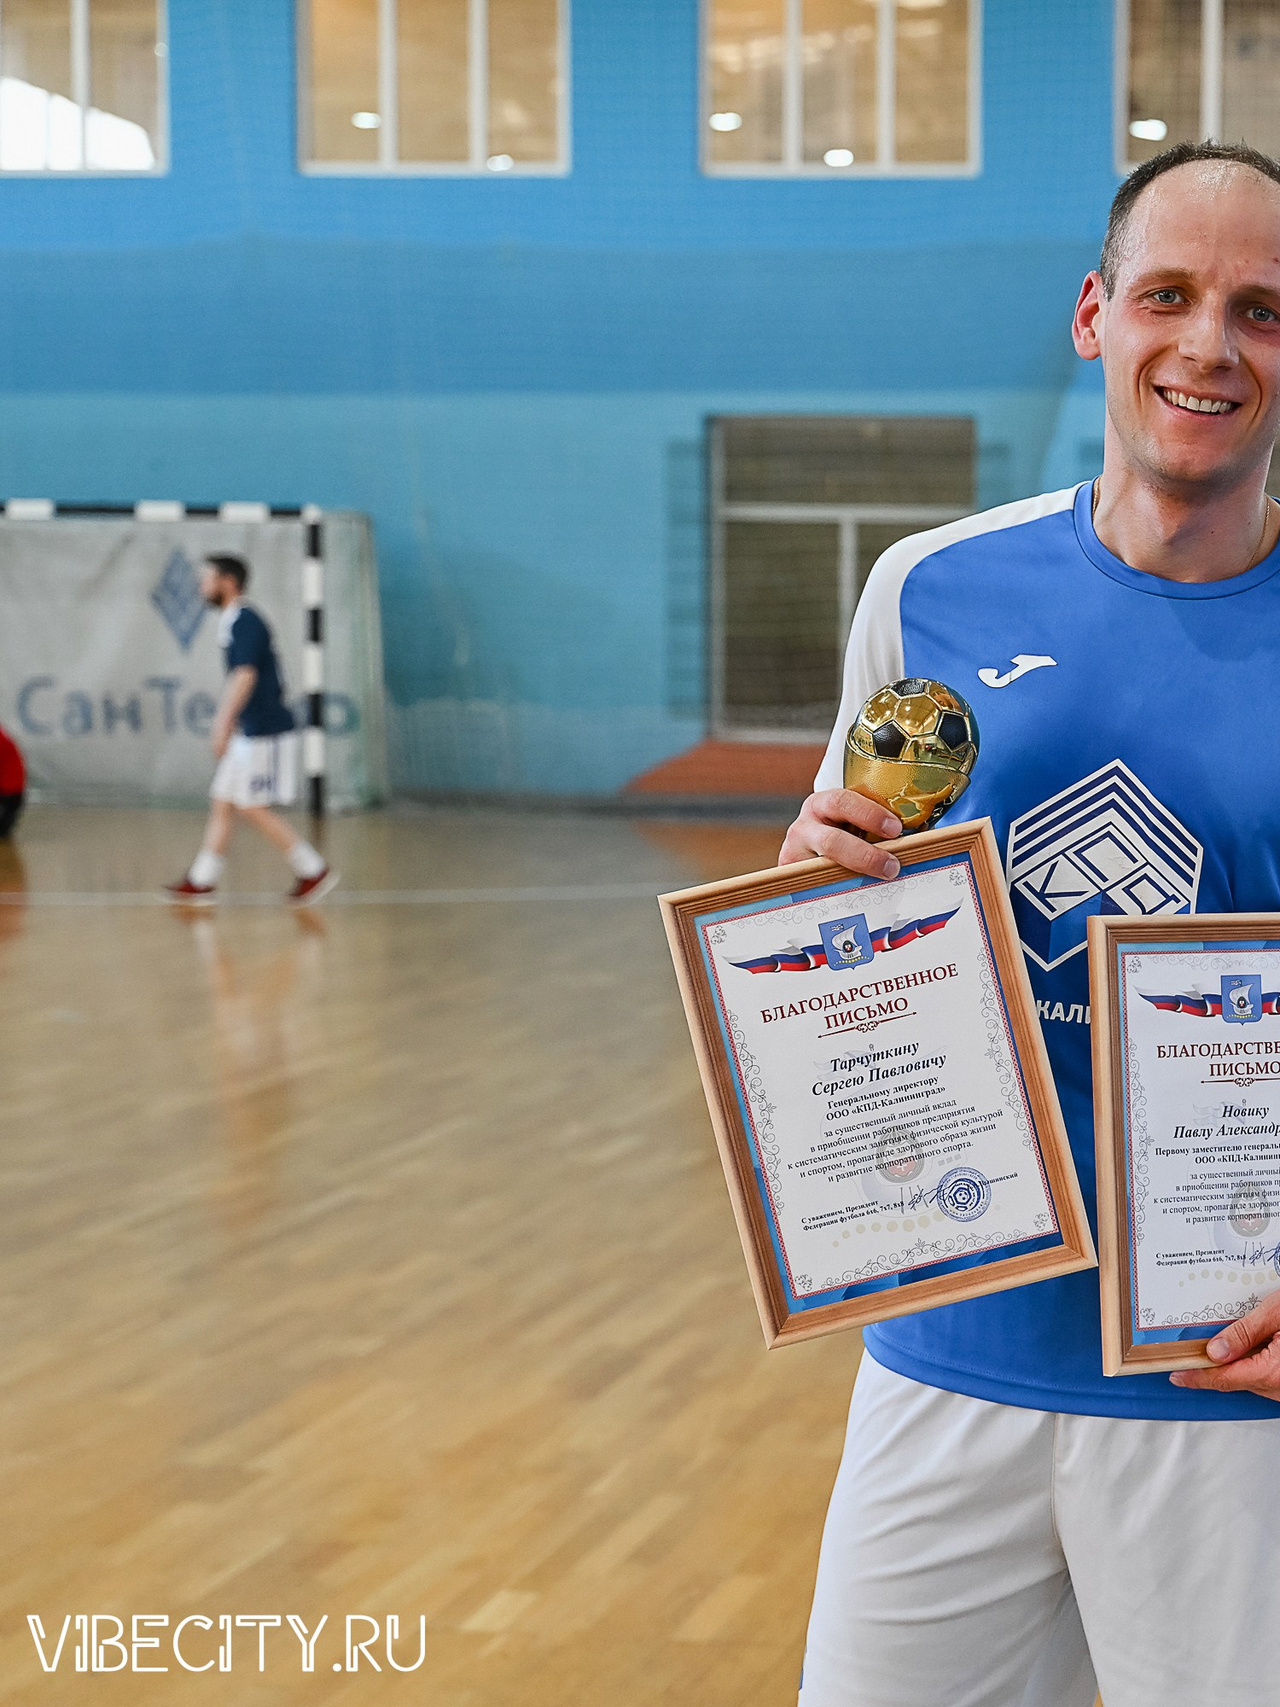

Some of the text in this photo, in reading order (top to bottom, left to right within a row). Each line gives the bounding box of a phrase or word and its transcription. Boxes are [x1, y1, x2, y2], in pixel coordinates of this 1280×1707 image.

[18, 676, 359, 737] СанТео
[759, 963, 959, 1024] БЛАГОДАРСТВЕННОЕ
[823, 997, 909, 1030] ПИСЬМО
[830, 1042, 919, 1073] Тарчуткину
[811, 1054, 947, 1096] Сергею Павловичу
[825, 1086, 946, 1121] ООО «КПД-Калининград»
[827, 1076, 939, 1110] Генеральному директору
[816, 1132, 871, 1152] приобщении
[872, 1119, 921, 1140] работников
[921, 1106, 976, 1126] предприятия
[834, 1112, 897, 1137] существенный
[898, 1104, 931, 1120] личный
[931, 1099, 958, 1111] вклад
[1221, 1105, 1270, 1120] Новику
[794, 1144, 868, 1169] систематическим
[868, 1134, 909, 1150] занятиям
[909, 1119, 960, 1142] физической
[960, 1108, 1004, 1127] культурой
[1173, 1125, 1214, 1140] Павлу
[807, 1162, 846, 1177] спортом,
[846, 1148, 895, 1168] пропаганде
[895, 1137, 939, 1154] здорового
[939, 1130, 969, 1143] образа
[969, 1123, 997, 1136] жизни
[835, 1165, 874, 1183] развитие
[874, 1148, 942, 1172] корпоративного
[942, 1141, 974, 1154] спорта.
[1155, 1147, 1191, 1158] Первому
[1191, 1144, 1243, 1154] заместителю
[1194, 1155, 1216, 1165] ООО
[1181, 1181, 1229, 1193] приобщении
[1230, 1179, 1273, 1191] работников
[1198, 1168, 1254, 1182] существенный
[1159, 1193, 1225, 1204] систематическим
[1225, 1191, 1261, 1200] занятиям
[1168, 1205, 1203, 1215] спортом,
[1204, 1202, 1247, 1214] пропаганде
[1192, 1215, 1226, 1225] развитие
